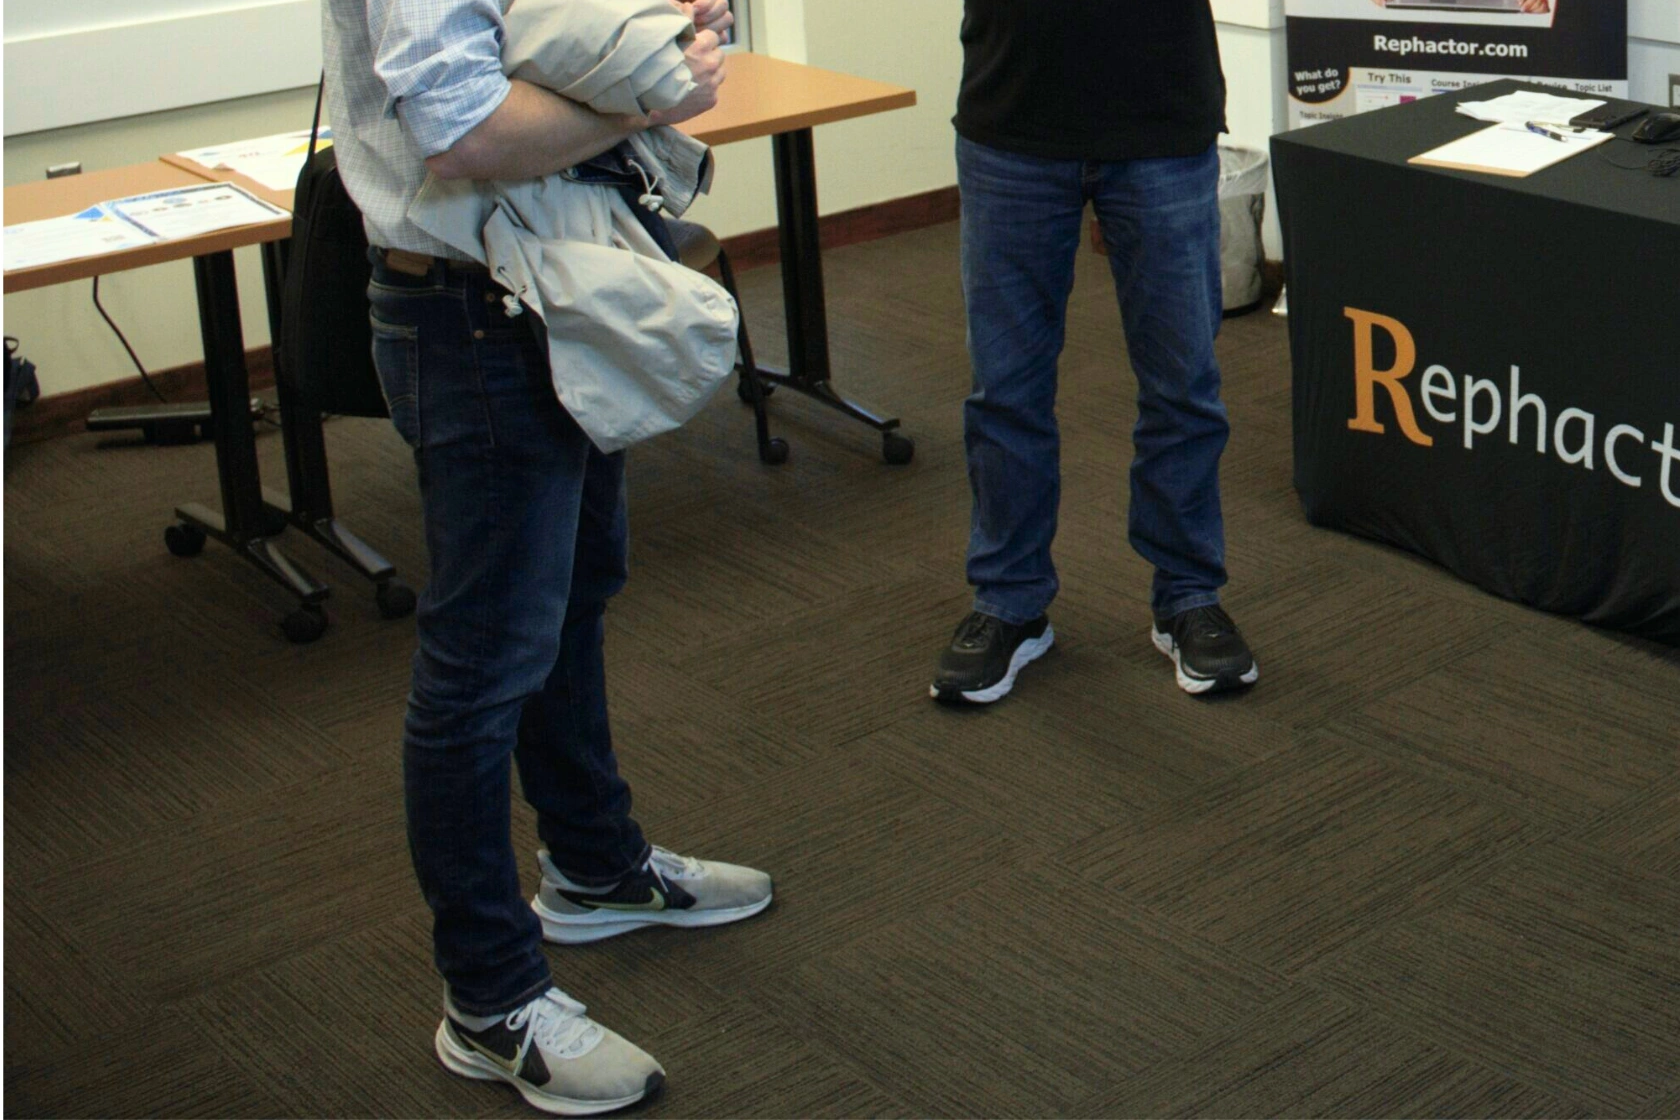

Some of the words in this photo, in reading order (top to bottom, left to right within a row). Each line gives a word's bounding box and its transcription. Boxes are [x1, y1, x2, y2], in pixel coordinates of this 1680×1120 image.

[1373, 34, 1529, 59] Rephactor.com
[1293, 70, 1323, 83] What
[1324, 67, 1340, 79] do
[1367, 72, 1386, 86] Try
[1390, 73, 1412, 85] This
[1295, 84, 1316, 97] you
[1317, 80, 1342, 96] get?
[1431, 78, 1461, 90] Course
[1575, 83, 1595, 95] Topic
[1597, 84, 1613, 93] List
